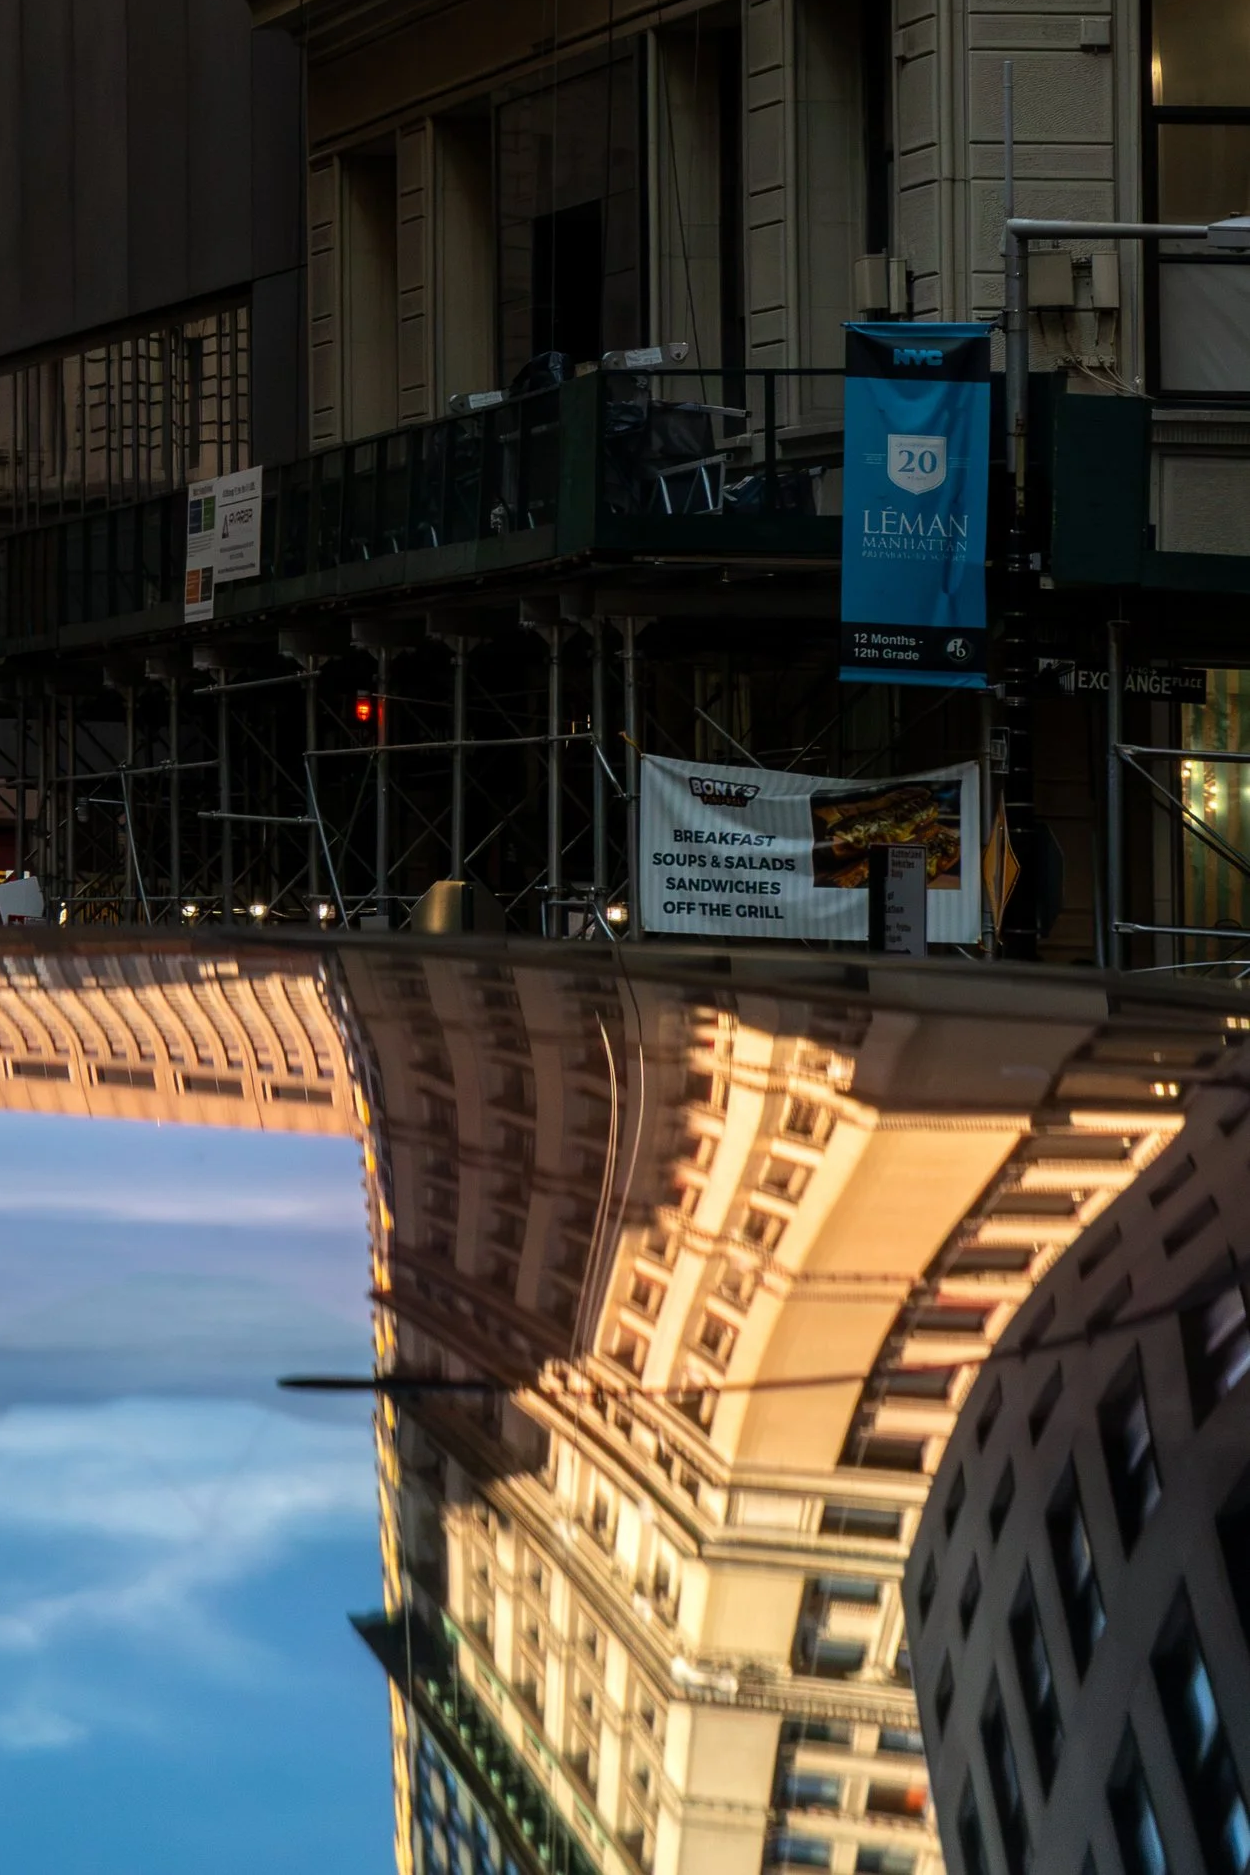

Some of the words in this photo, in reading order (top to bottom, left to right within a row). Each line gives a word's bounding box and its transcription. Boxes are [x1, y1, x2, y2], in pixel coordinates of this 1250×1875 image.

[893, 348, 944, 366] NYC
[898, 450, 937, 474] 20
[862, 506, 969, 538] LÉMAN
[862, 536, 967, 552] MANHATTAN
[854, 633, 868, 644] 12
[871, 635, 916, 646] Months
[854, 648, 879, 659] 12th
[883, 648, 920, 661] Grade
[1078, 670, 1173, 695] EXCANGE
[1172, 676, 1203, 690] PLACE
[690, 778, 759, 798] BONY'S
[673, 829, 776, 847] BREAKFAST
[652, 853, 707, 868] SOUPS
[711, 856, 721, 868] &
[724, 856, 795, 871] SALADS
[666, 877, 781, 895] SANDWICHES
[663, 901, 696, 915] OFF
[698, 903, 732, 917] THE
[736, 904, 784, 919] GRILL
